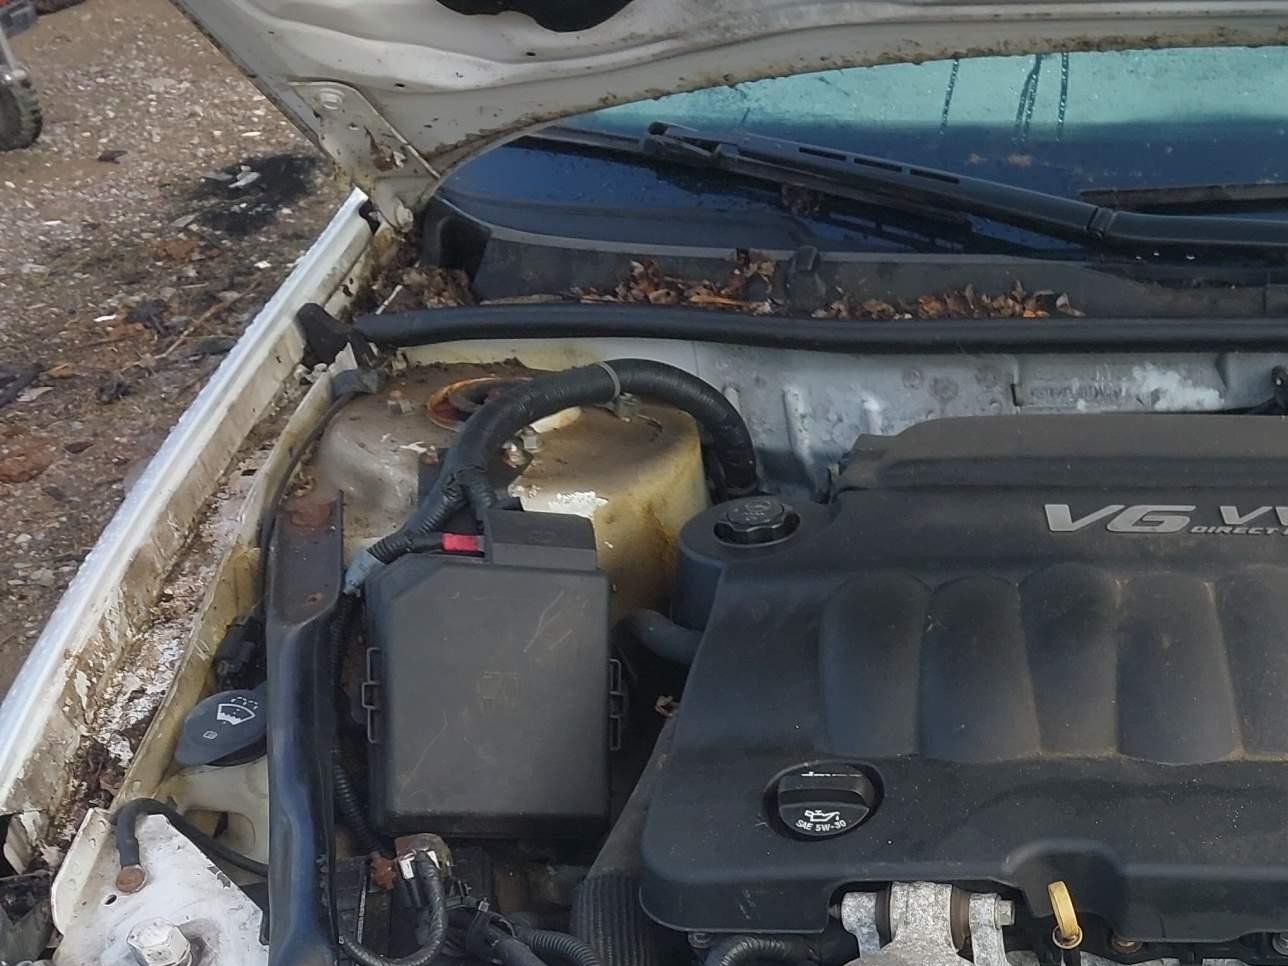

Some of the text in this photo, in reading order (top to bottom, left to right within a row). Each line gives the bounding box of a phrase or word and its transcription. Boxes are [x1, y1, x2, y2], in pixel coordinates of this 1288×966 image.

[1044, 503, 1196, 533] V6
[1191, 526, 1276, 535] DIRECT
[795, 820, 846, 831] SAE 5W-30
